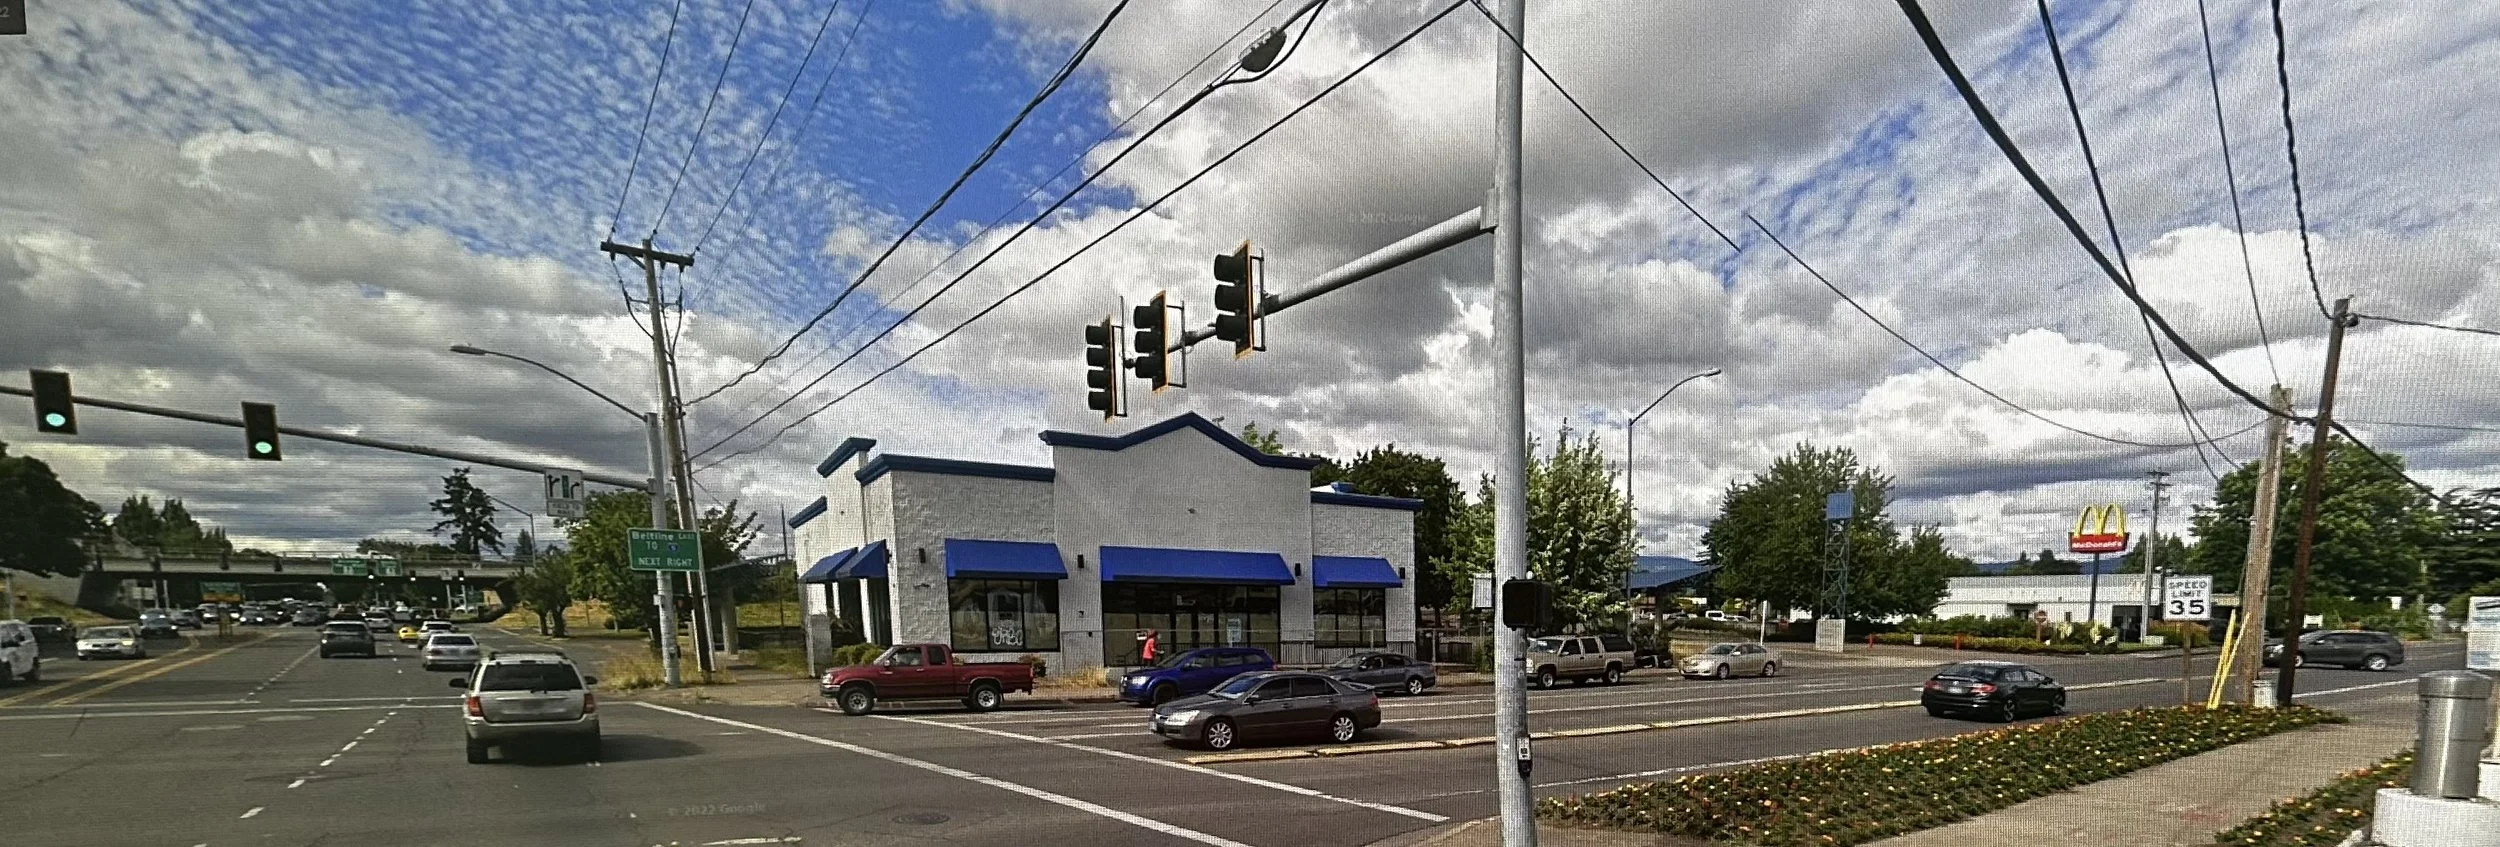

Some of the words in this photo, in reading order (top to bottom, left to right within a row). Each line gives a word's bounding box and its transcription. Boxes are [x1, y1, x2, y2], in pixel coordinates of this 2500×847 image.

[631, 531, 674, 541] Beltline
[645, 541, 658, 550] TO
[638, 557, 660, 566] NEXT
[666, 557, 692, 567] RIGHT
[2168, 581, 2207, 589] SPEED
[2171, 590, 2202, 598] LIMIT
[2169, 600, 2204, 615] 35
